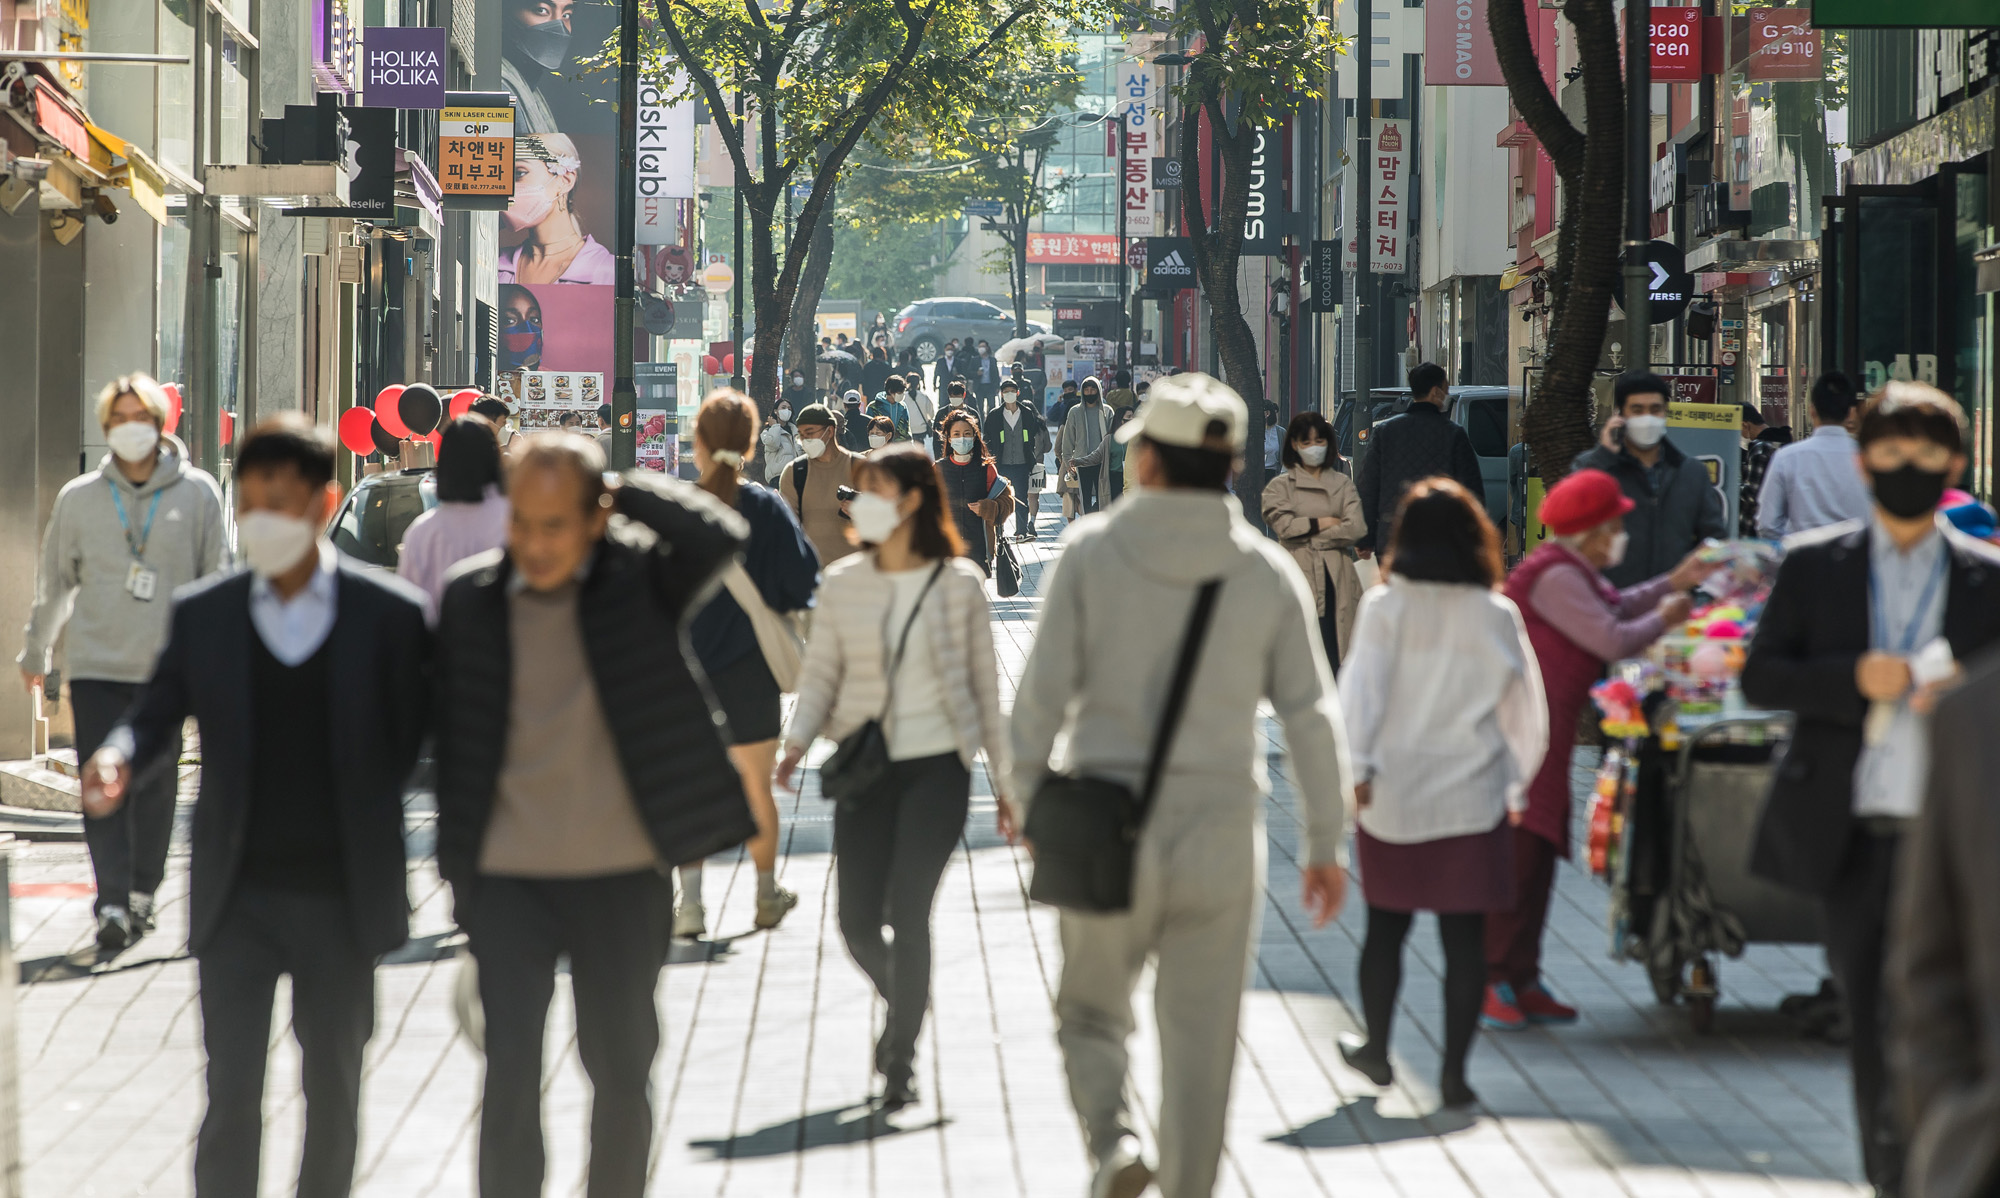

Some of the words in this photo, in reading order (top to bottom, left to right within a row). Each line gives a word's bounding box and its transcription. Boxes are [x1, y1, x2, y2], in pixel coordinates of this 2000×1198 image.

[1649, 24, 1689, 37] acao
[371, 51, 439, 66] HOLIKA
[371, 69, 439, 85] HOLIKA
[464, 124, 489, 134] CNP
[448, 140, 505, 161] 차앤박
[448, 164, 504, 181] 피부과
[350, 199, 386, 208] eseller
[1377, 156, 1400, 257] 맘스터치
[1126, 216, 1150, 224] 3-6622
[1153, 266, 1191, 275] adidas
[1370, 262, 1402, 270] 77-6073
[1322, 247, 1331, 306] SKINFOOD
[1677, 383, 1701, 394] erry
[1032, 479, 1042, 487] NI
